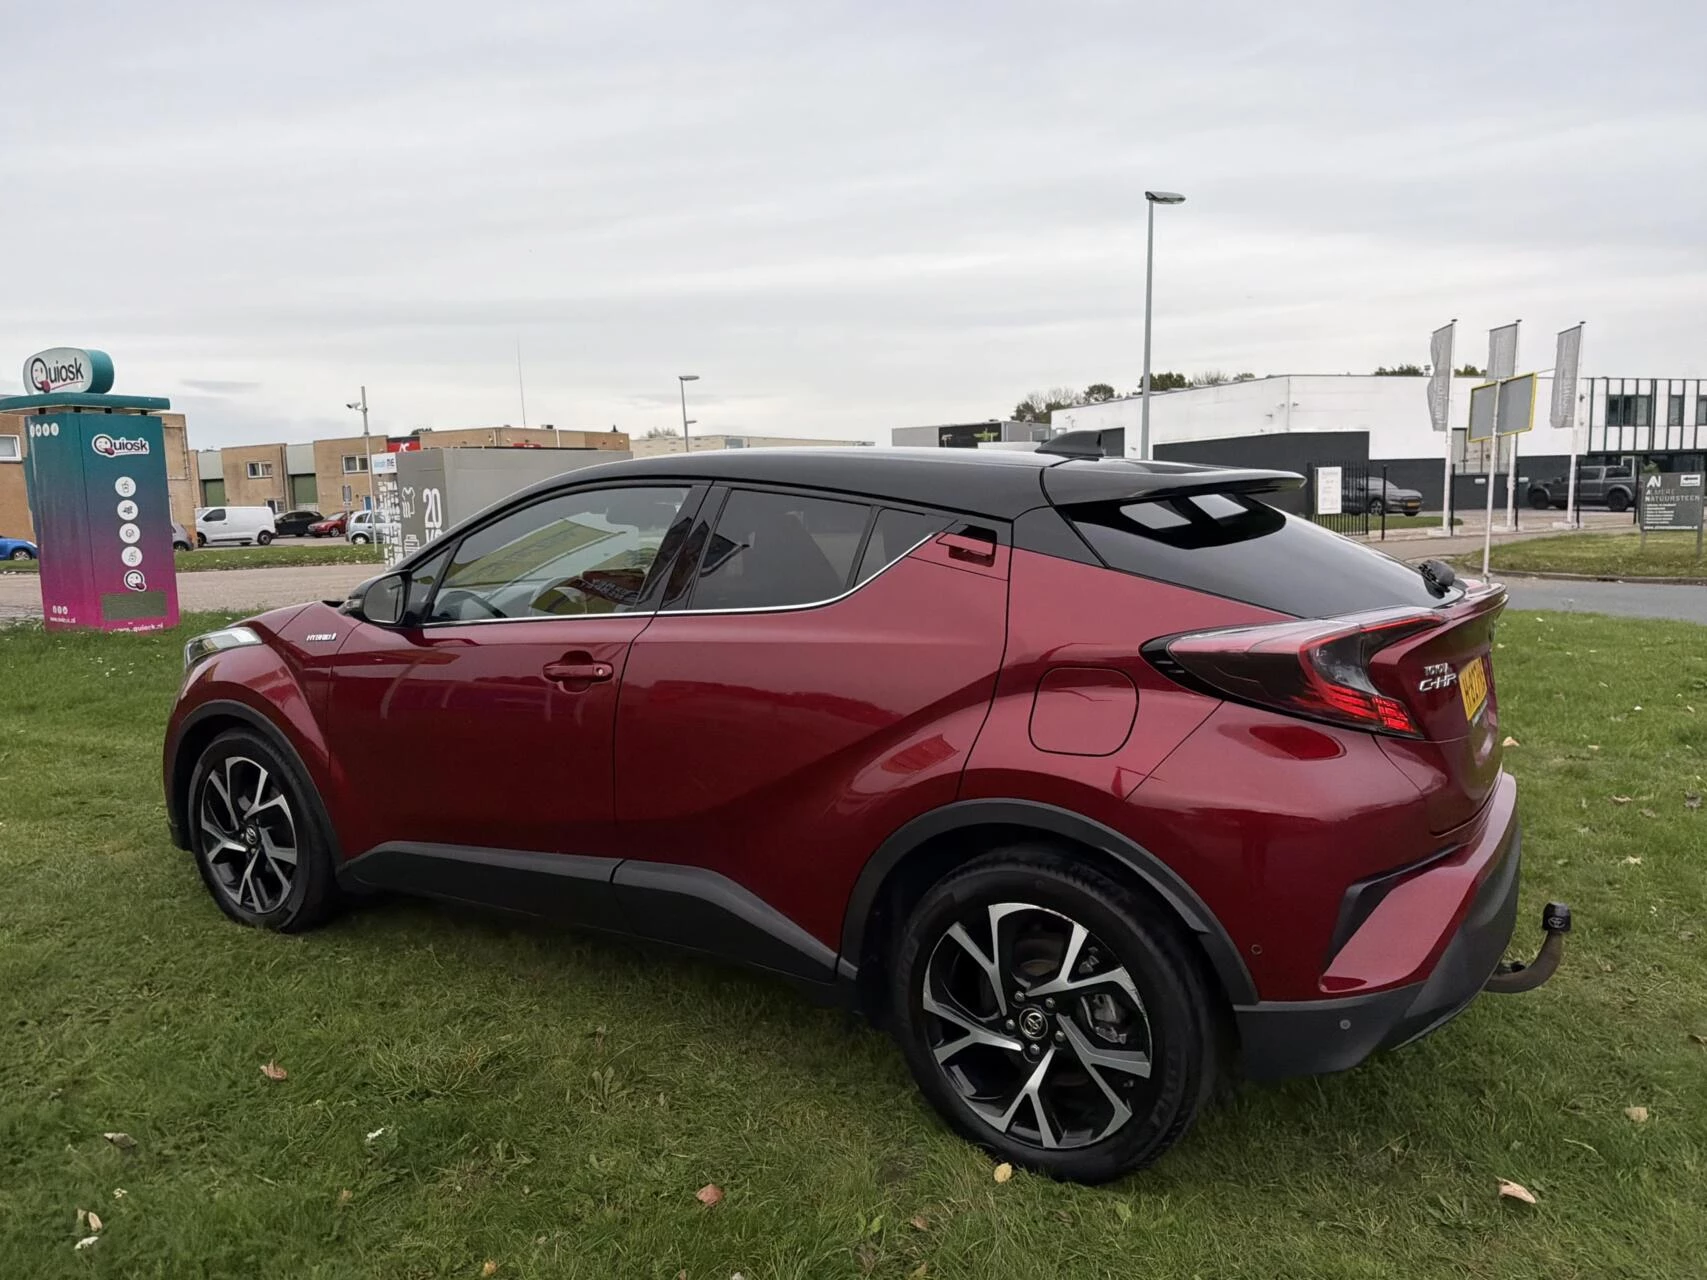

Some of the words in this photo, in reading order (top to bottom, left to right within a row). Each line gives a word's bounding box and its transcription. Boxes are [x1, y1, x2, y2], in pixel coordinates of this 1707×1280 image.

[31, 357, 84, 393] Quiosk
[94, 435, 148, 455] Quiosk
[423, 488, 442, 528] 20
